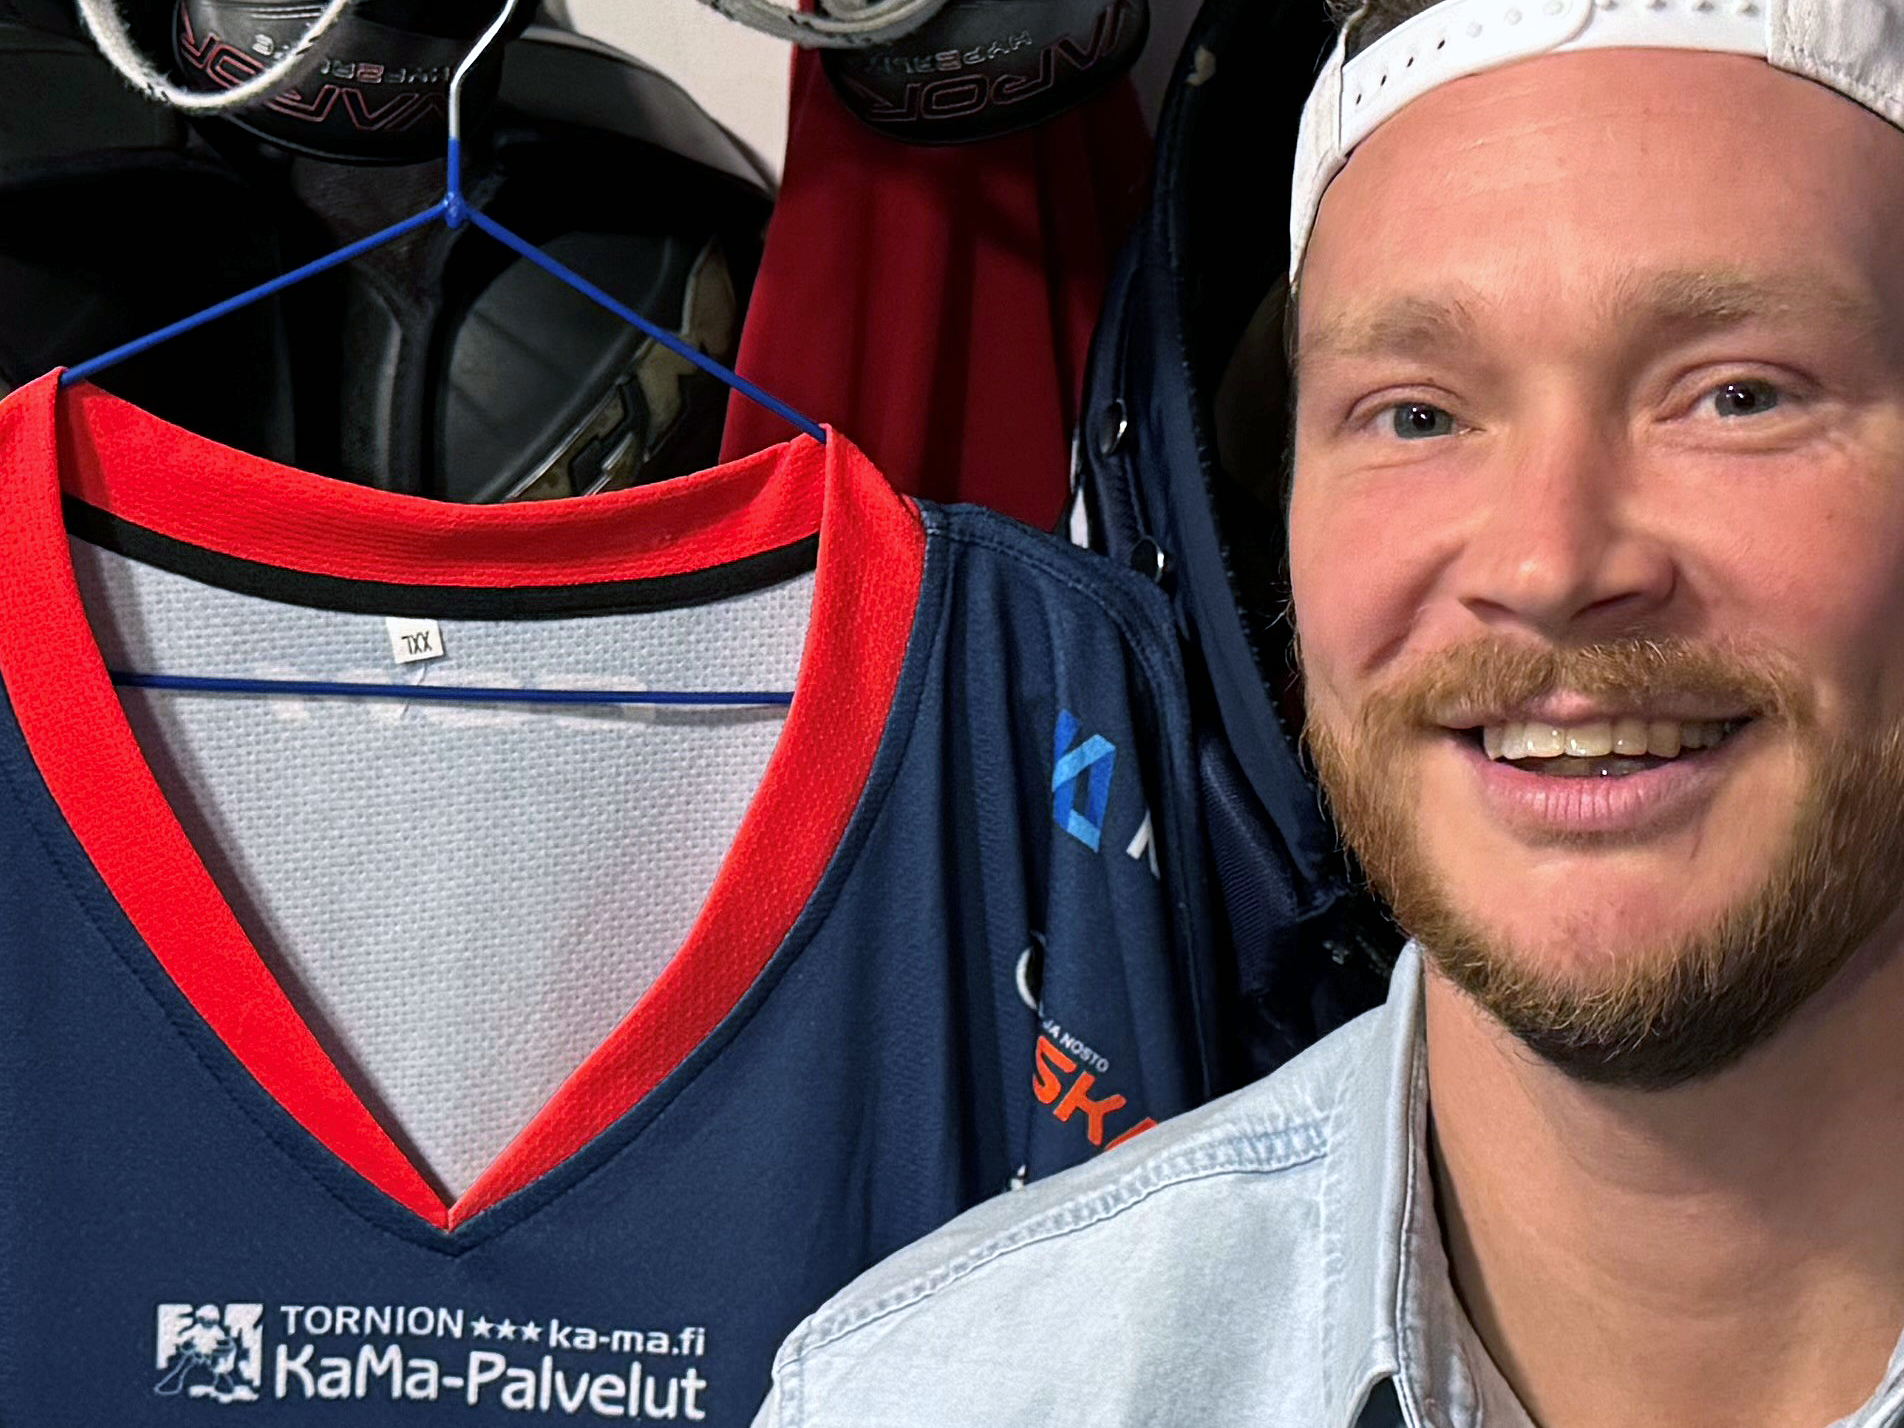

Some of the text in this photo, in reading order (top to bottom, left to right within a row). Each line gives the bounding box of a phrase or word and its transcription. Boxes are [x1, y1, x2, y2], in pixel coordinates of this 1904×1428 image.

[281, 1305, 706, 1356] TORNION ka-ma.fi
[275, 1343, 707, 1420] KaMa-Palvelut
